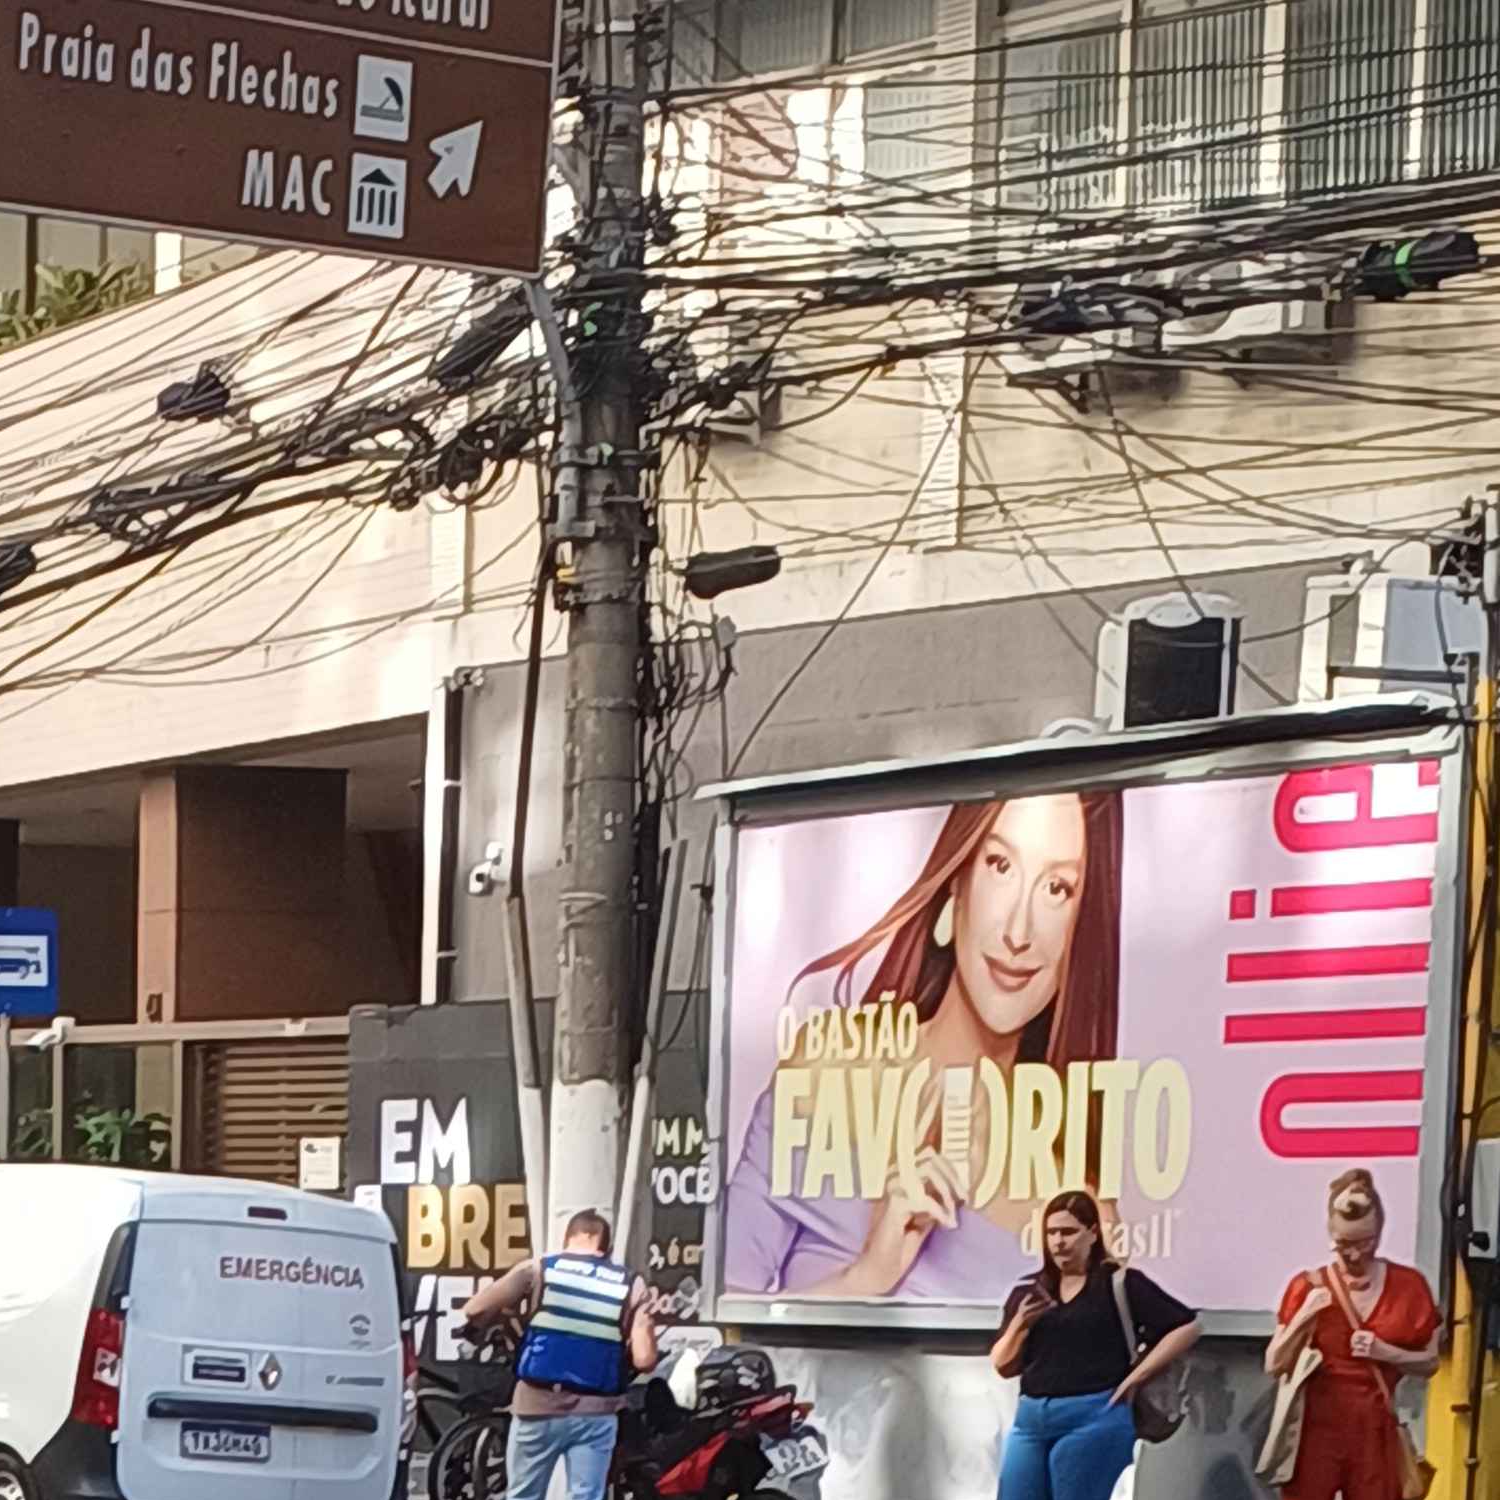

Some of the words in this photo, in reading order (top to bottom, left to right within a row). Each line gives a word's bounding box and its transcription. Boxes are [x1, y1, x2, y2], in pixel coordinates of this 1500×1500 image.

[19, 13, 114, 83] Praia
[130, 28, 194, 95] das
[209, 42, 340, 118] Flechas
[240, 149, 334, 217] MAC
[777, 1004, 797, 1060] O
[805, 990, 919, 1060] BASTÃO
[380, 1097, 471, 1185] EM
[1102, 1209, 1174, 1258] rasil
[219, 1256, 365, 1290] EMERGÊNCIA
